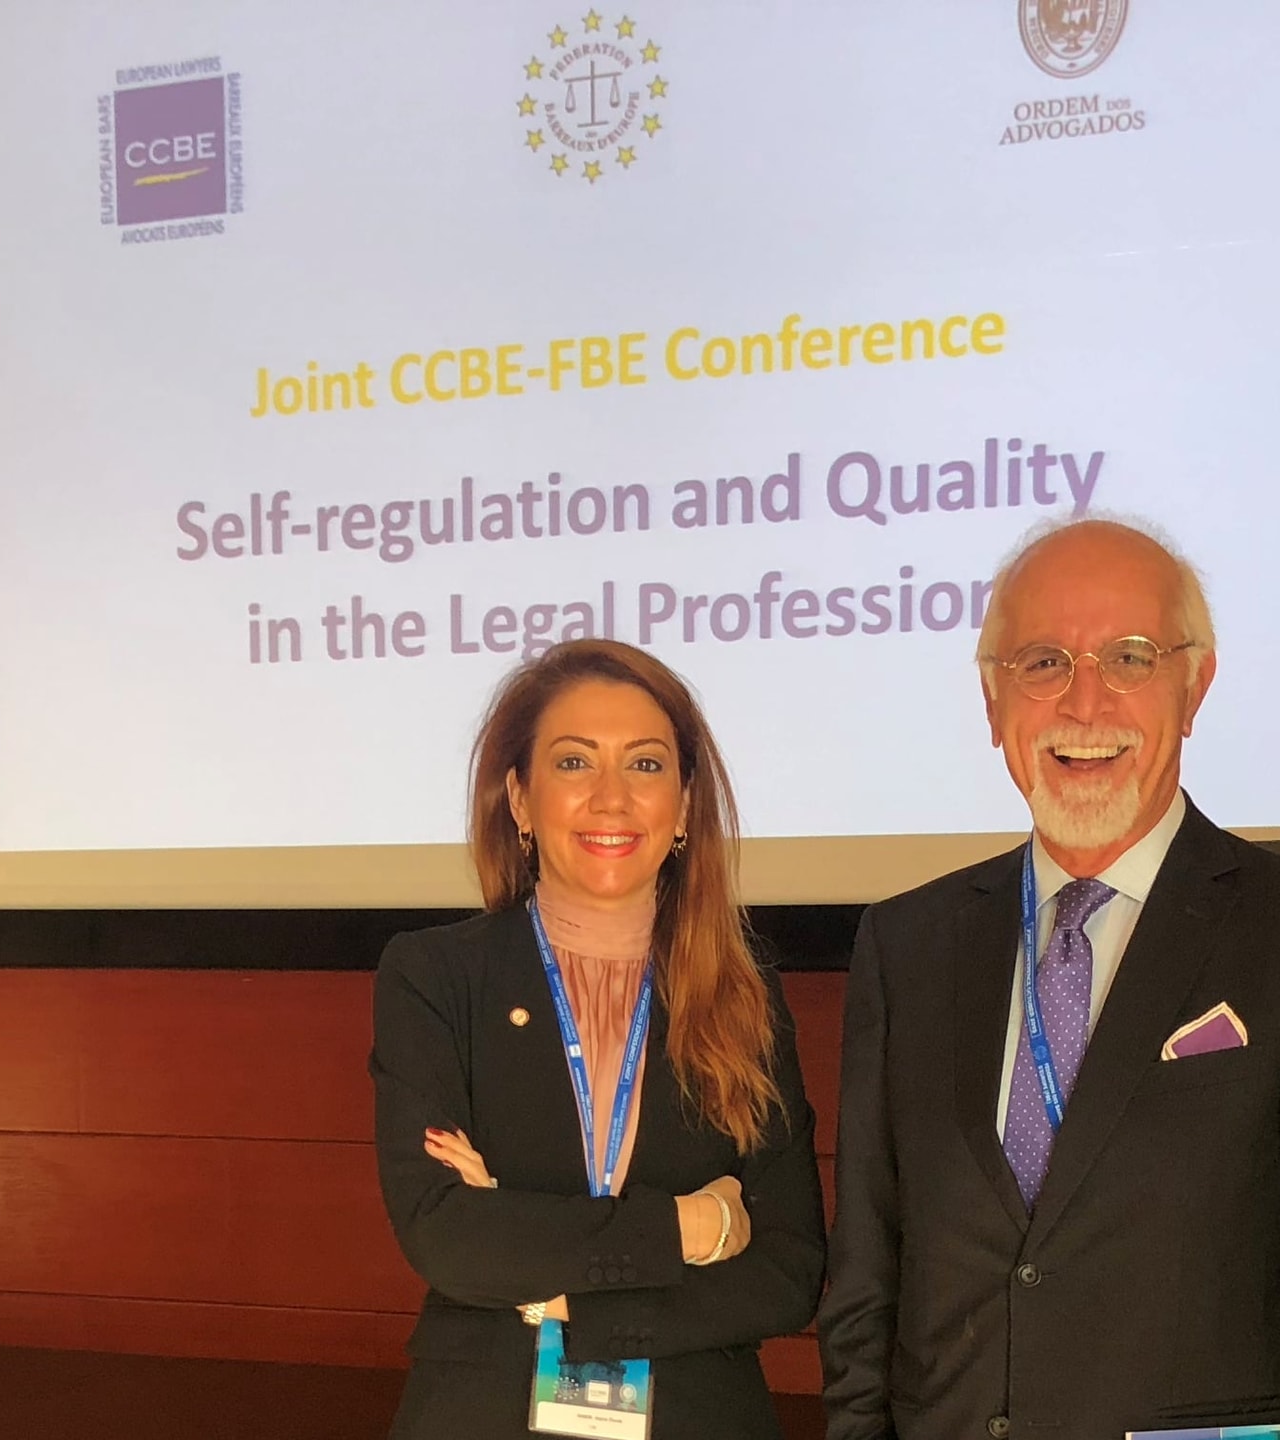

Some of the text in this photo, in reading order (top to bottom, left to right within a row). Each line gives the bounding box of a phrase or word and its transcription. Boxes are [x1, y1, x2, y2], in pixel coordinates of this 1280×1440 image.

[998, 110, 1146, 146] ADVOGADOS
[1013, 94, 1100, 122] ORDEM
[124, 132, 216, 168] CCBE
[249, 310, 1007, 418] Joint CCBE-FBE Conference
[176, 437, 1106, 563] Self-regulation and Quality
[247, 602, 303, 664] in
[320, 595, 427, 661] the
[449, 580, 615, 660] Legal
